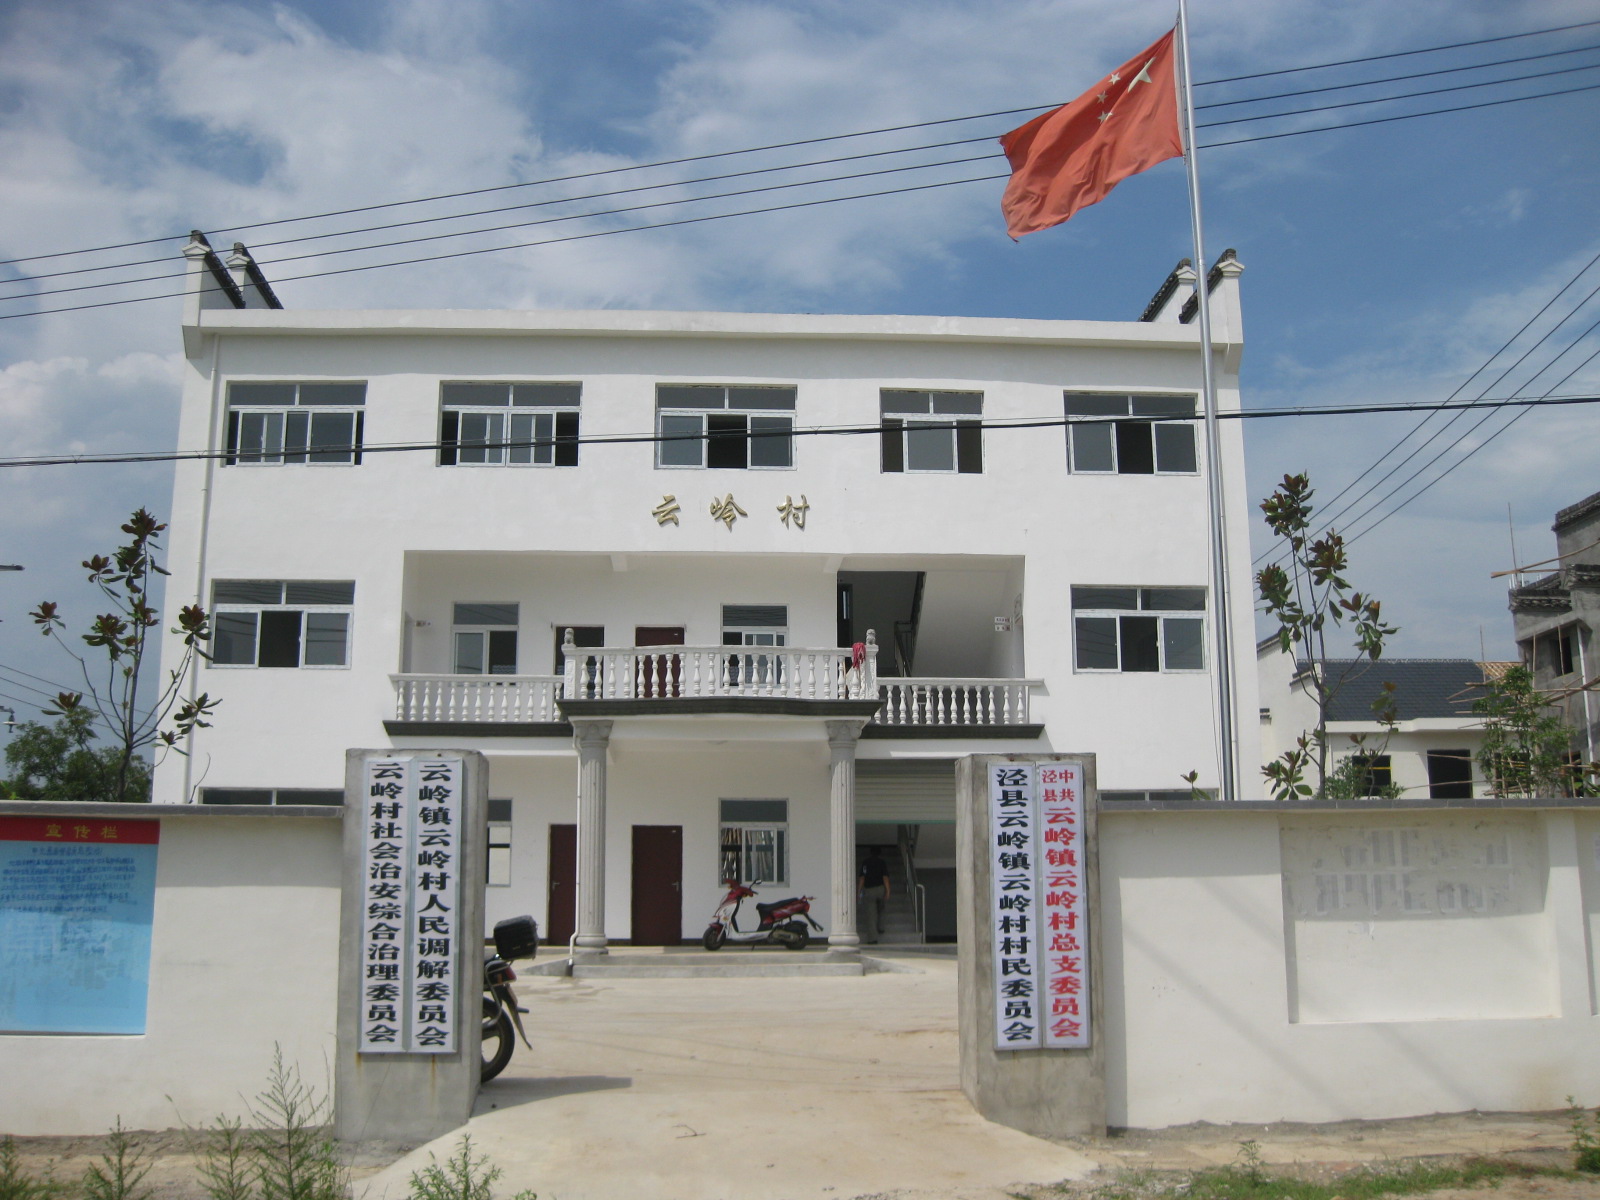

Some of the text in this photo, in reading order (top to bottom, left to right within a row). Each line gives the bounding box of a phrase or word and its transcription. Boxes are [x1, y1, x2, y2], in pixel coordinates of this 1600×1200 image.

[652, 493, 810, 532] 云岭村
[45, 824, 118, 839] 宣传栏
[366, 762, 404, 1042] 云岭村社会治安综合治理委员会
[416, 764, 452, 1046] 云岭镇云岭村人民调解委员会
[997, 768, 1035, 1041] 泾县云岭镇云岭村村民委员会
